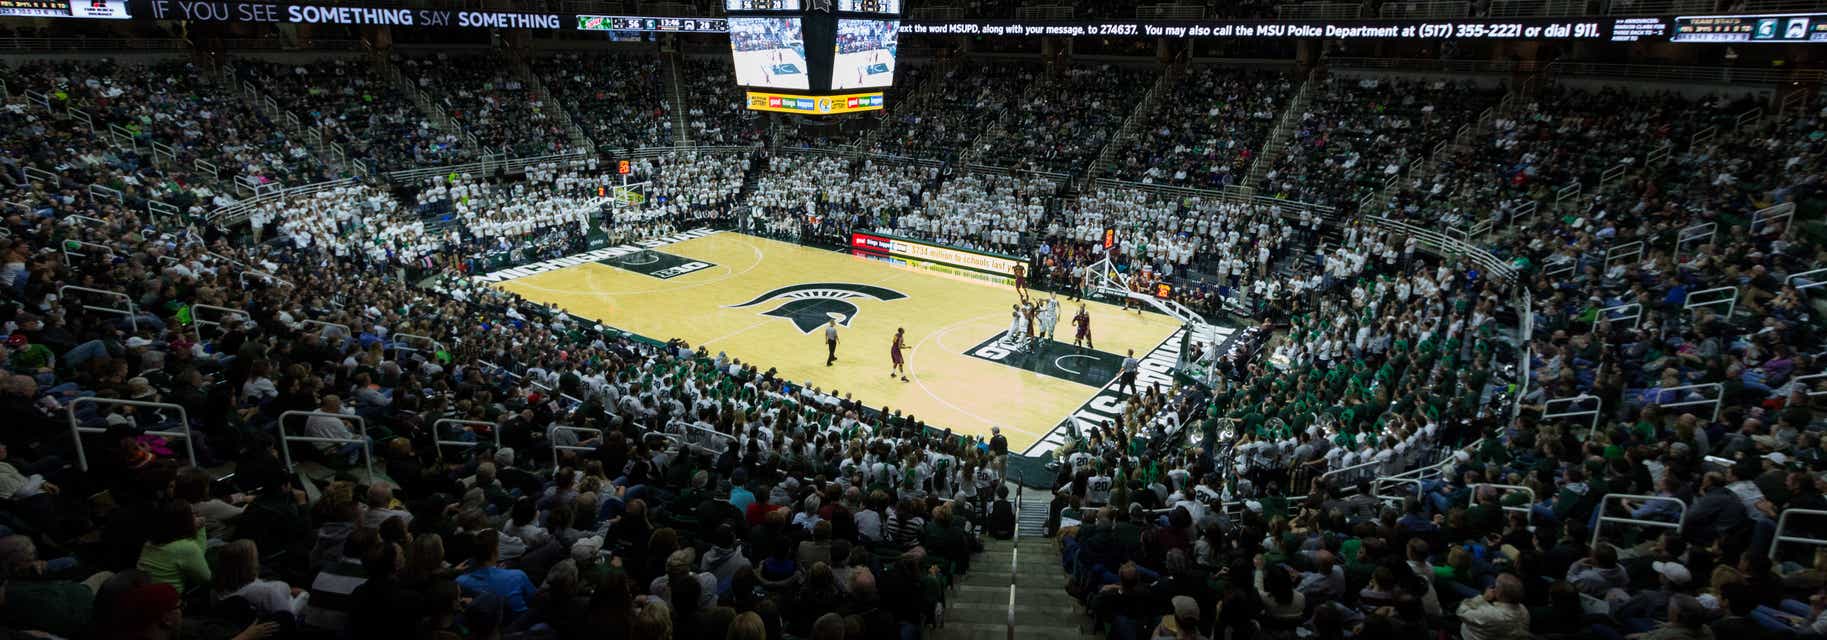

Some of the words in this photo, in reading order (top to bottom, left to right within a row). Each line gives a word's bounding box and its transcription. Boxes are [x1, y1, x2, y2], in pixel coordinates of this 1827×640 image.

[152, 1, 168, 18] IF
[179, 2, 229, 20] YOU
[239, 4, 279, 22] SEE
[288, 5, 413, 25] SOMETHING
[420, 11, 449, 26] SAY
[459, 12, 560, 28] SOMETHING
[628, 20, 640, 28] 56
[898, 24, 912, 33] ext
[914, 24, 927, 33] the
[929, 24, 947, 33] word
[949, 24, 980, 34] MSUPD,
[982, 24, 1003, 35] along
[1006, 24, 1023, 34] with
[1025, 26, 1044, 35] your
[1046, 26, 1085, 36] message,
[1088, 25, 1098, 34] to
[1100, 24, 1138, 35] 274637.
[1145, 25, 1163, 35] You
[1165, 27, 1186, 37] may
[1189, 25, 1210, 35] also
[1213, 25, 1232, 35] call
[1235, 25, 1253, 36] the
[1256, 25, 1285, 36] MSU
[1288, 25, 1322, 36] Police
[1325, 25, 1399, 39] Department
[1401, 26, 1416, 37] at
[1419, 23, 1453, 38] (517)
[1456, 24, 1522, 38] 355-2221
[1525, 27, 1541, 37] or
[1544, 24, 1571, 37] dial
[1574, 23, 1600, 38] 911.
[472, 244, 640, 284] MICHIGAN
[1076, 457, 1088, 467] 20
[1094, 481, 1107, 491] 20
